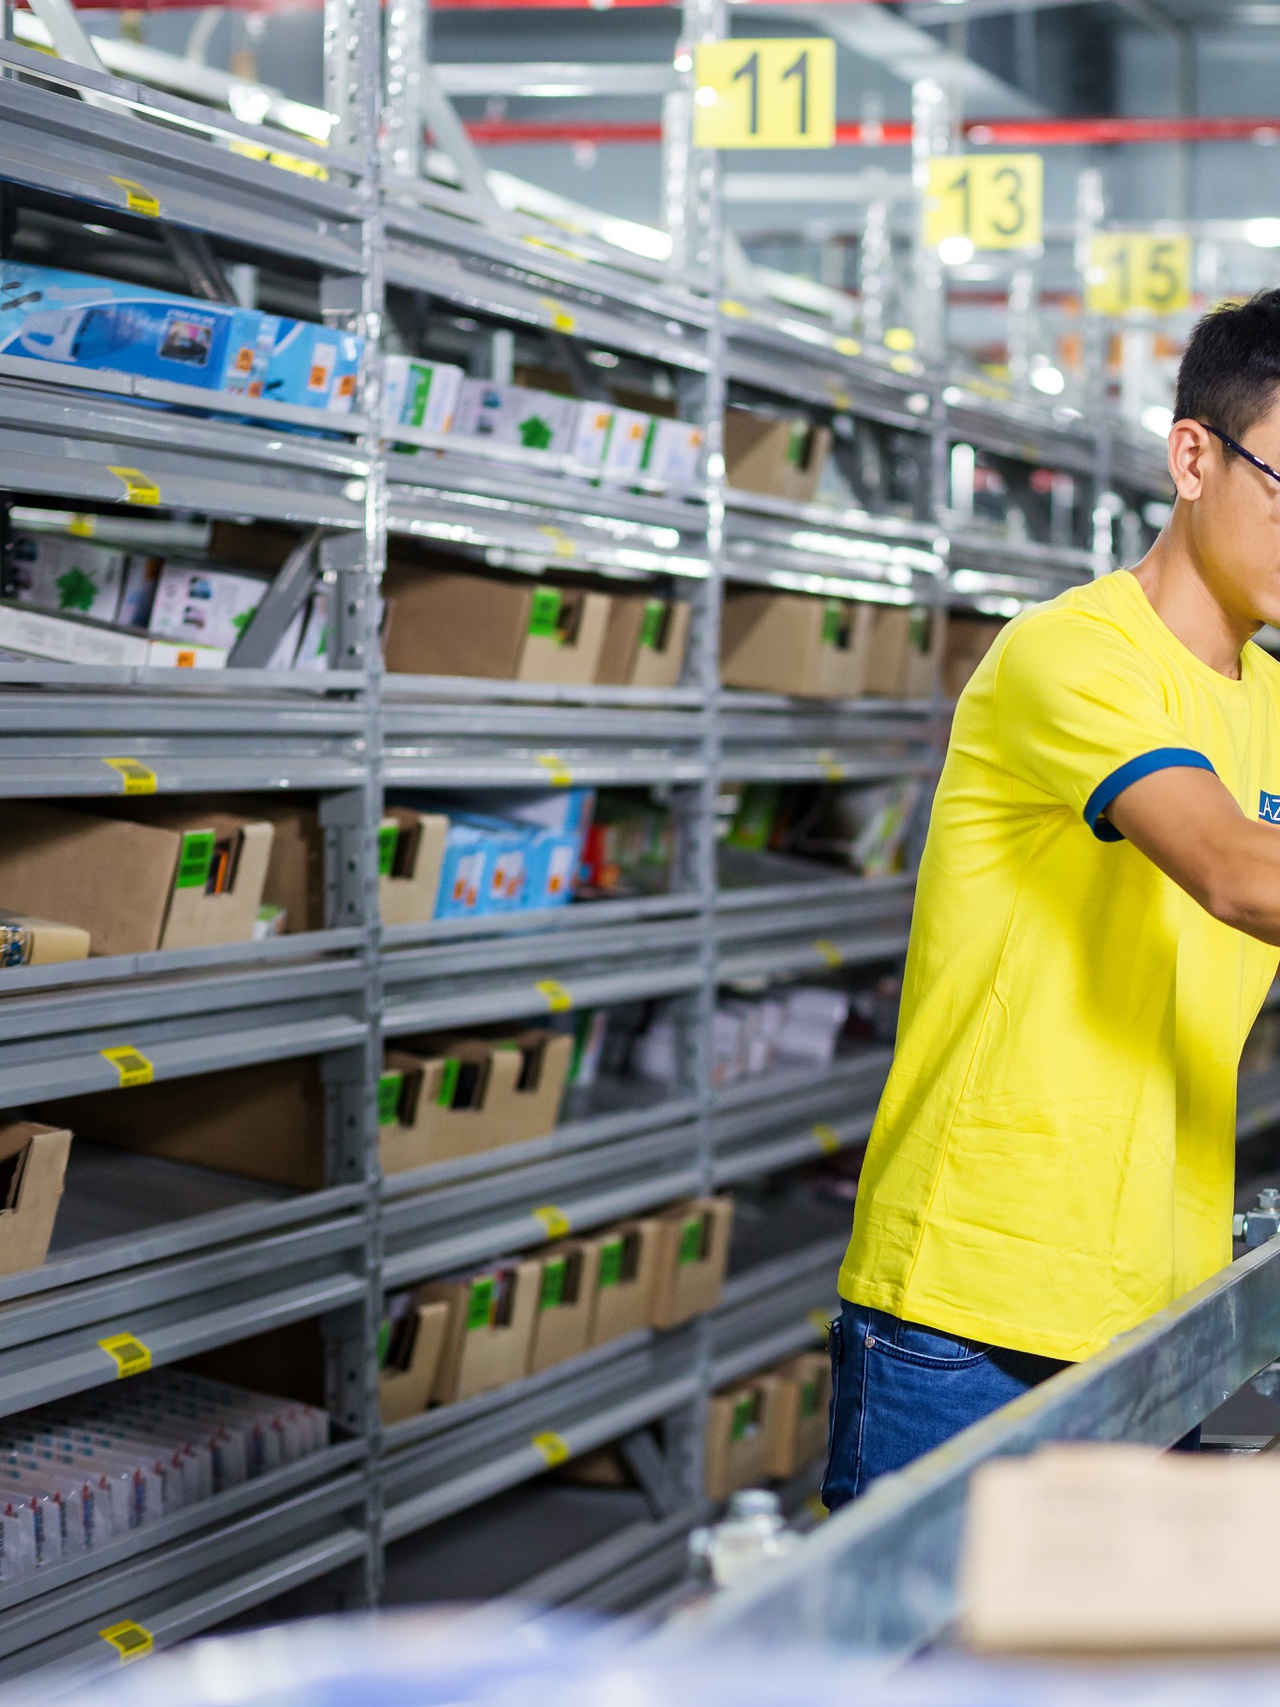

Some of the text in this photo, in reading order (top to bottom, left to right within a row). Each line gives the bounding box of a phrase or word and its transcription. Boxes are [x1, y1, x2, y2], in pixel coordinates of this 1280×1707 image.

[731, 51, 809, 135] 11
[948, 166, 1027, 236] 13
[1110, 244, 1180, 303] 15
